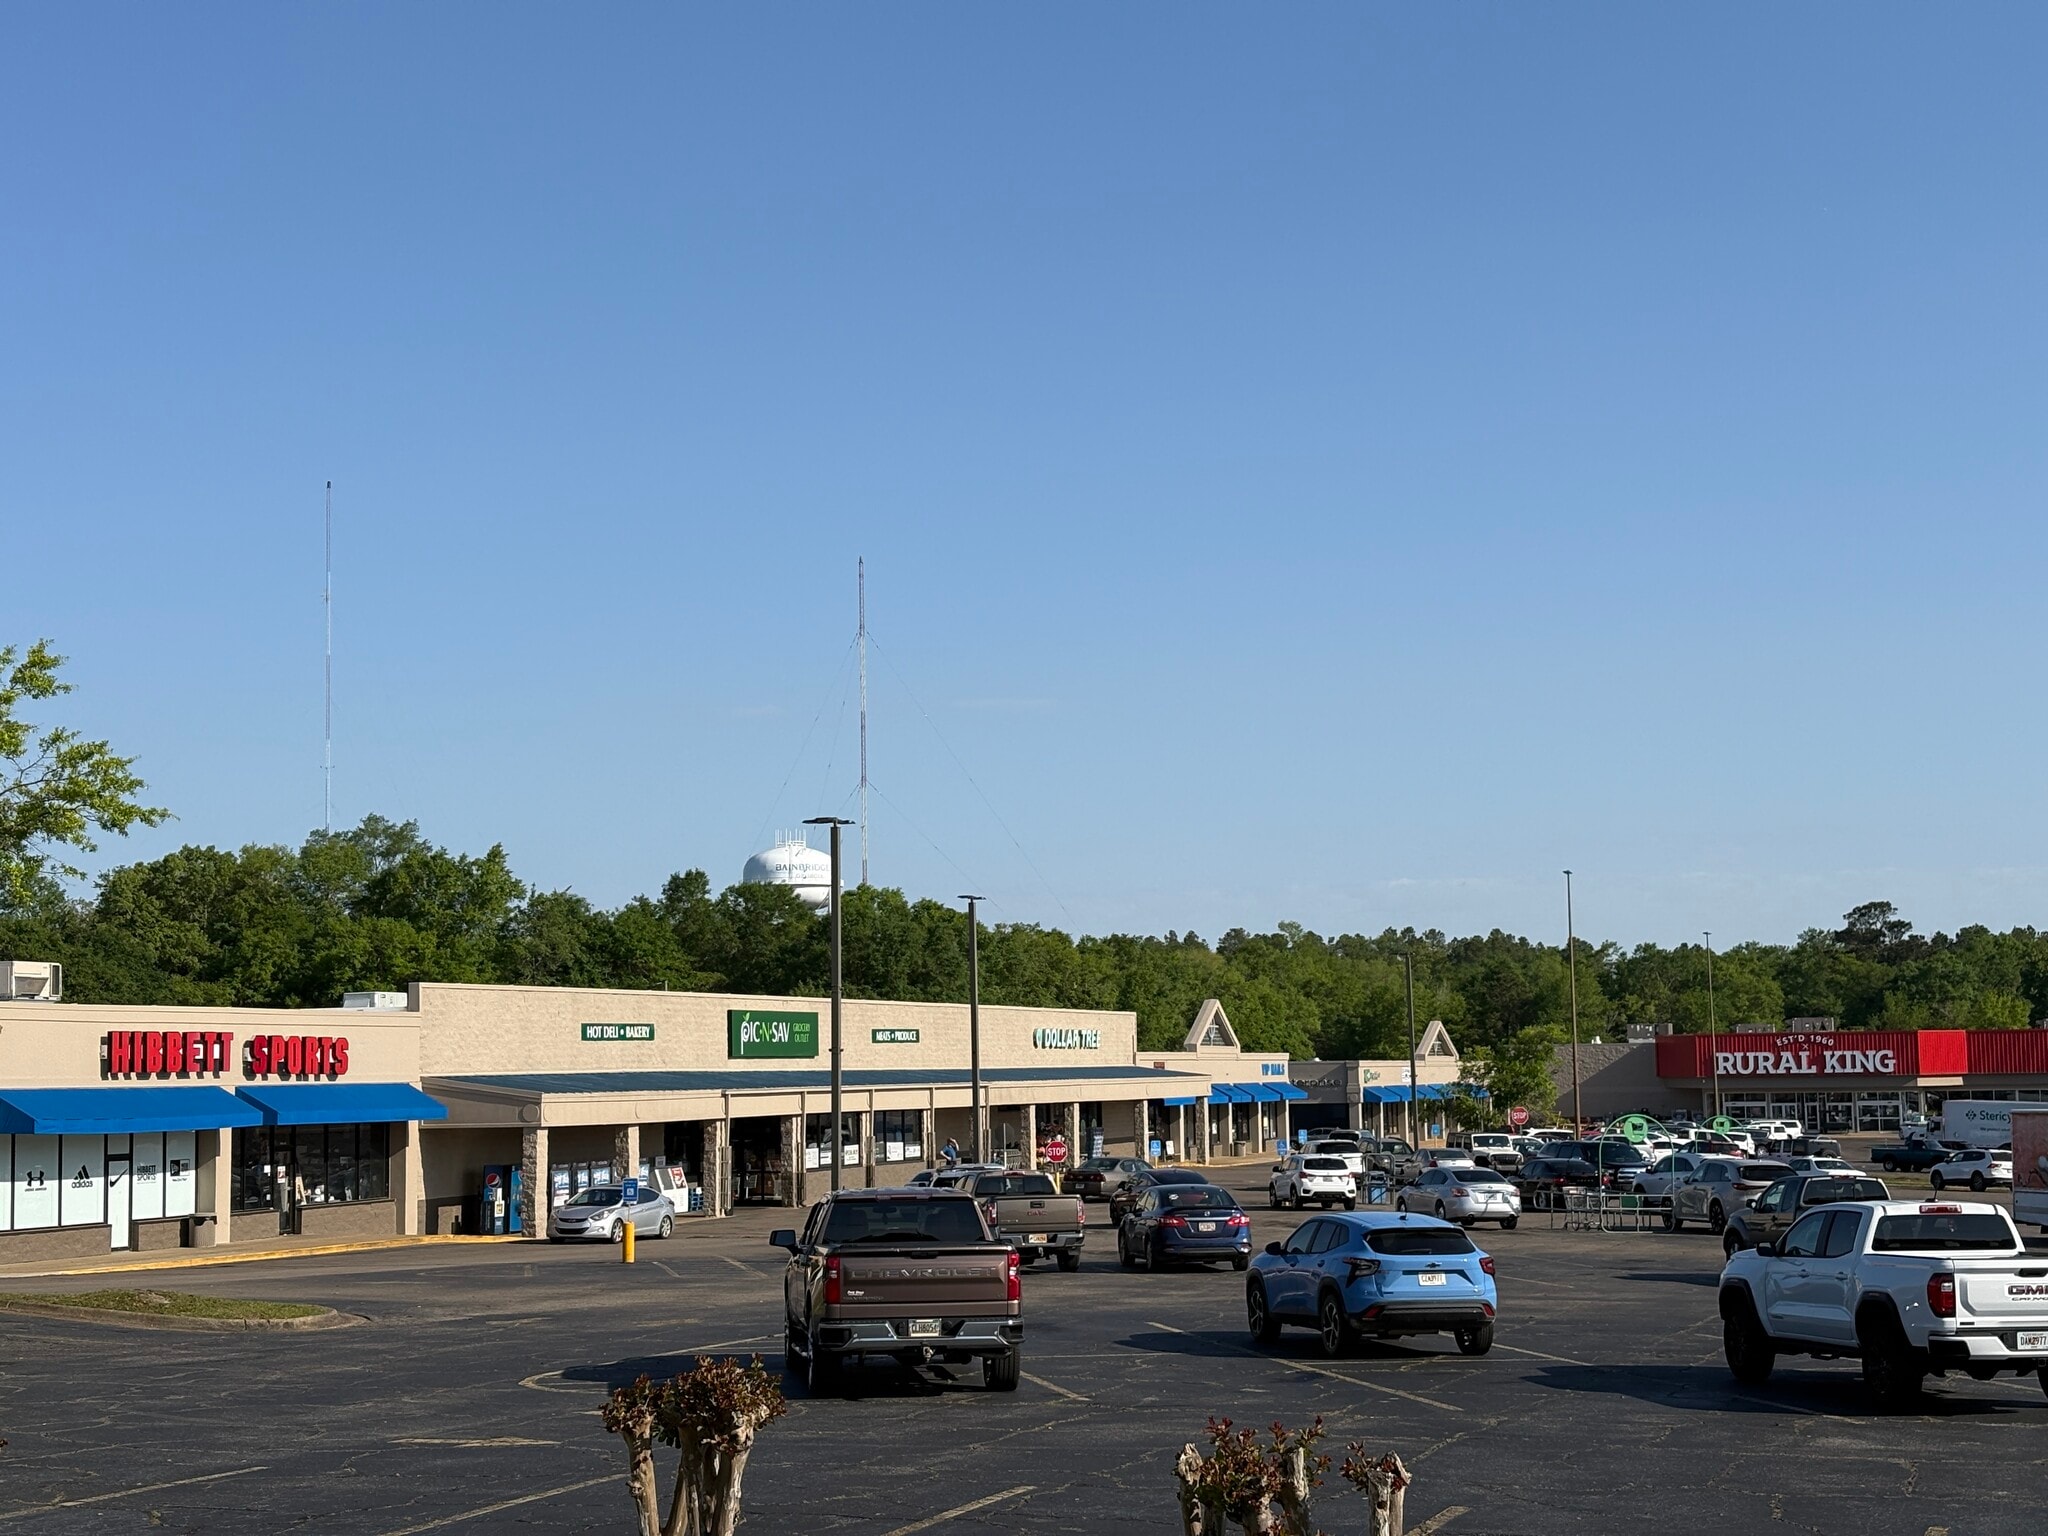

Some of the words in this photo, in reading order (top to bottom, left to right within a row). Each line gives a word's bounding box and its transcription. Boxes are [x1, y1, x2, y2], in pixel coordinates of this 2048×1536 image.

[587, 1026, 602, 1038] HOT
[603, 1026, 618, 1038] DELI
[626, 1026, 650, 1038] BAKERY
[793, 1023, 811, 1031] GROCERY
[1045, 1028, 1080, 1047] DOLLAR
[1081, 1029, 1101, 1048] TREE
[1810, 1034, 1835, 1047] 1960
[108, 1031, 234, 1073] HIBBETT
[253, 1035, 349, 1075] SPORTS
[1716, 1051, 1817, 1075] RURAL
[1823, 1050, 1896, 1074] KING
[1291, 1078, 1342, 1088] terprise
[1979, 1110, 2012, 1124] Stericy
[1047, 1147, 1066, 1156] STOP
[71, 1180, 93, 1189] adidas
[852, 1267, 996, 1279] CHEVROLET
[2008, 1285, 2048, 1296] GM
